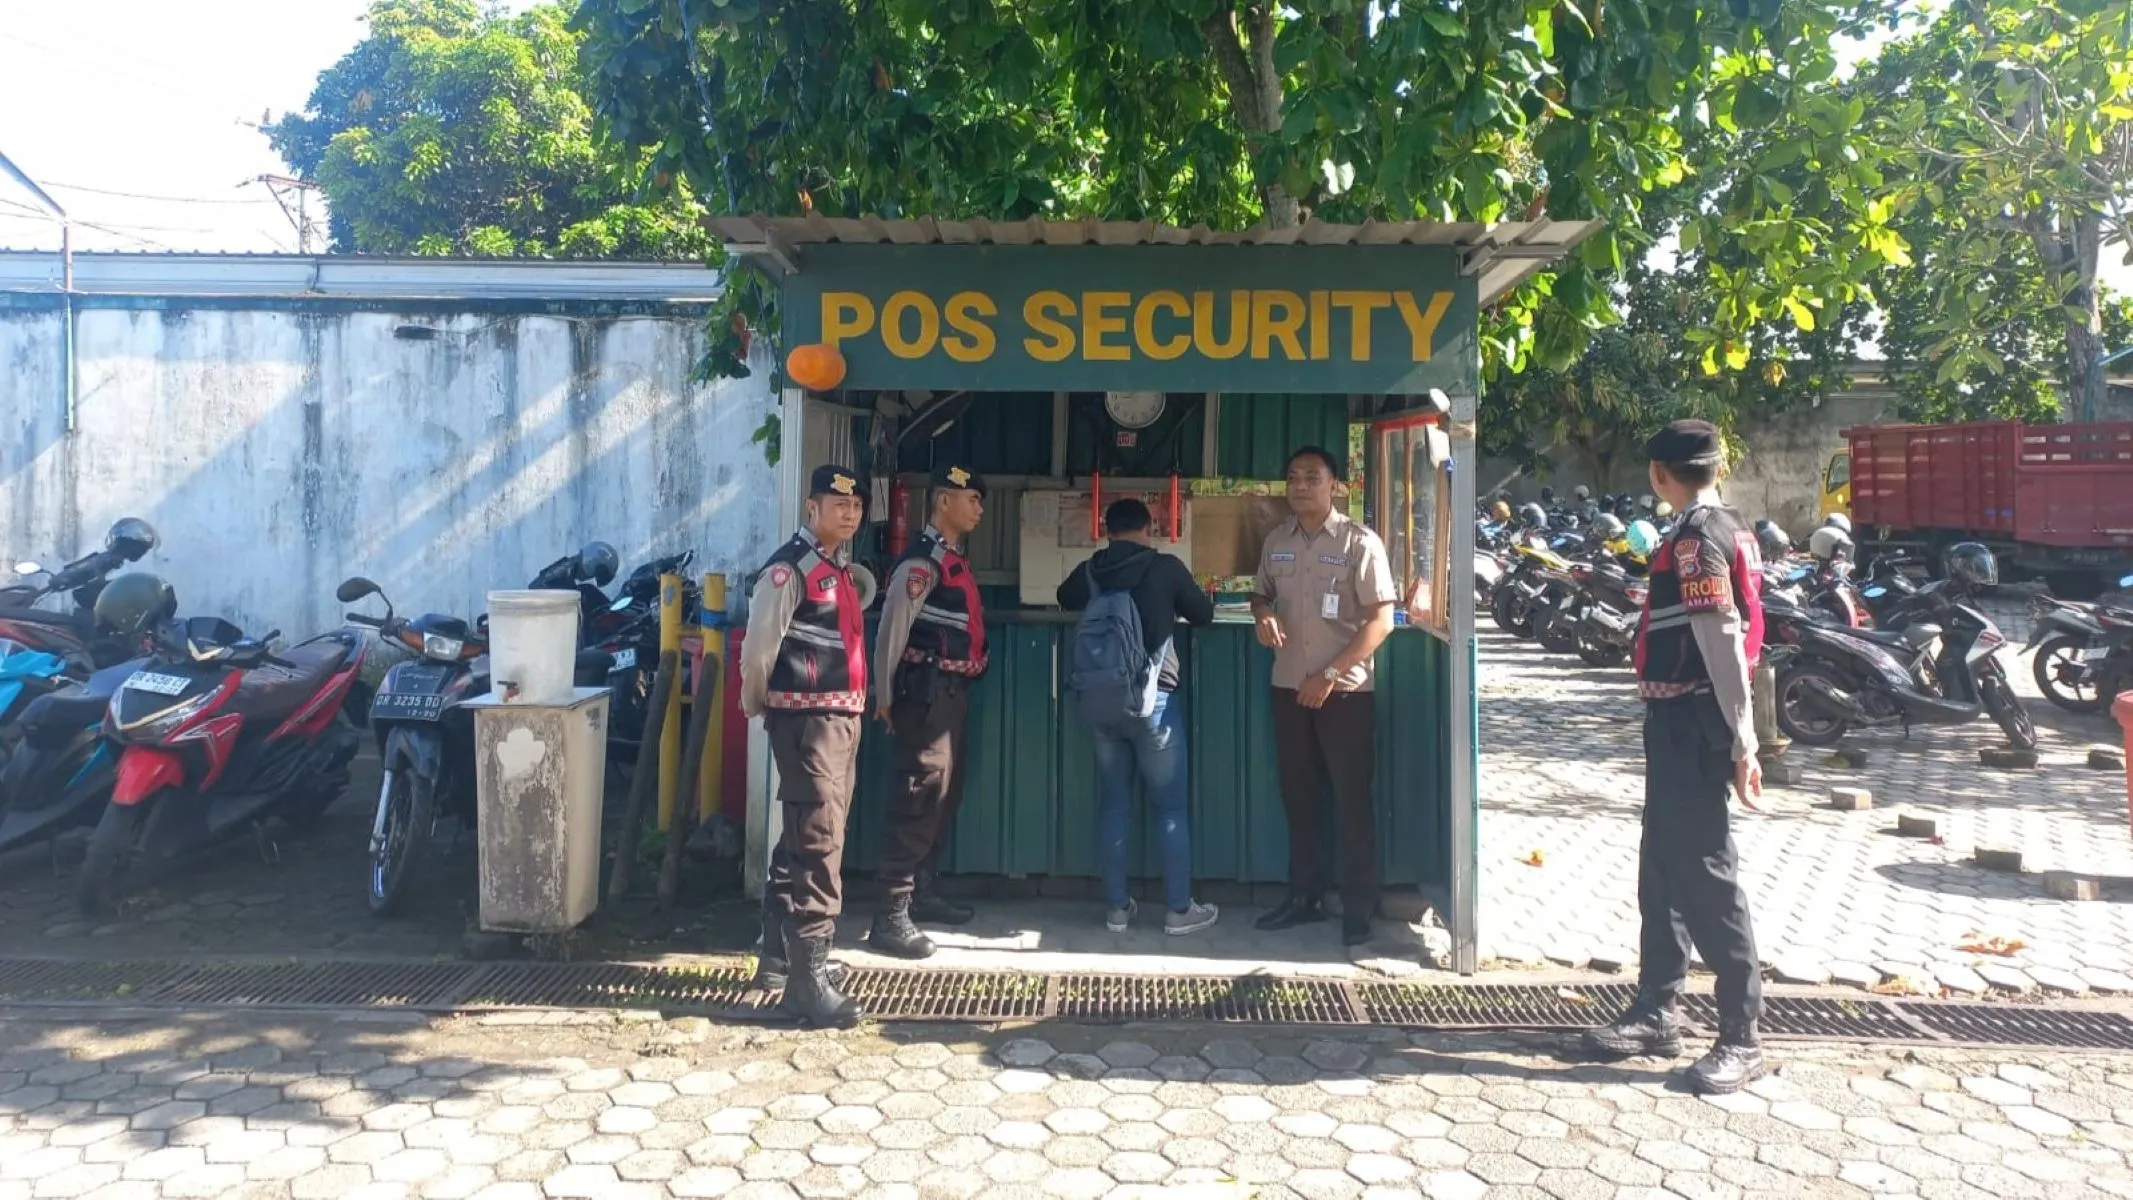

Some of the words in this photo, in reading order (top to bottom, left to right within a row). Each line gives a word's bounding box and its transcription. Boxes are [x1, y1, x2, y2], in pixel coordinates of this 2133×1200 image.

[820, 290, 998, 362] POS
[1023, 290, 1454, 362] SECURITY
[393, 695, 422, 706] 3235
